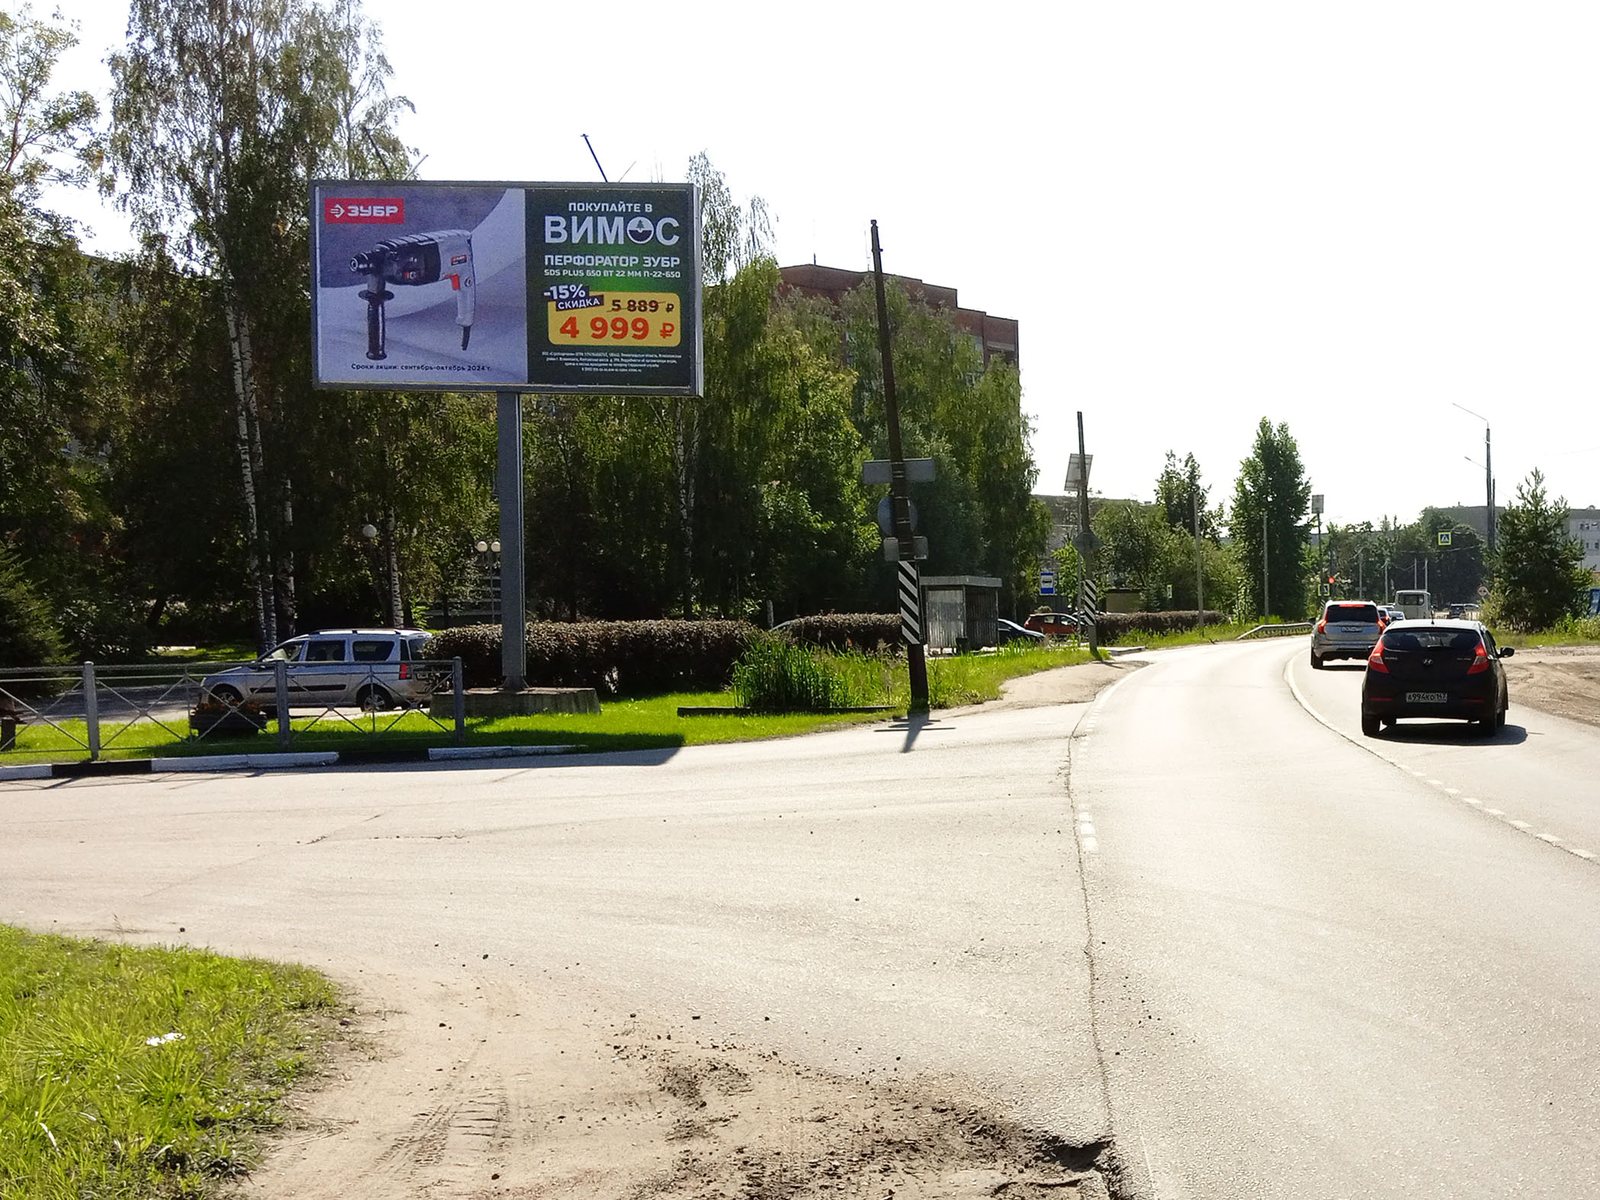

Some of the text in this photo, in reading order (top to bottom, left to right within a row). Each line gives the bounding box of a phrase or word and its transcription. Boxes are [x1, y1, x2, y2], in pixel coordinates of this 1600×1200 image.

[347, 205, 399, 217] ЗУБР
[568, 201, 653, 213] ПОКУПАЙТЕ В
[544, 215, 680, 246] ВИМОС
[544, 254, 681, 268] ПЕРФОРАТОР ЗУБР
[543, 284, 586, 300] -15%
[557, 297, 601, 310] СКИДКА
[611, 299, 622, 312] 5
[626, 299, 660, 313] 889
[559, 316, 579, 339] 4
[589, 316, 649, 340] 999
[351, 363, 374, 371] Сроки
